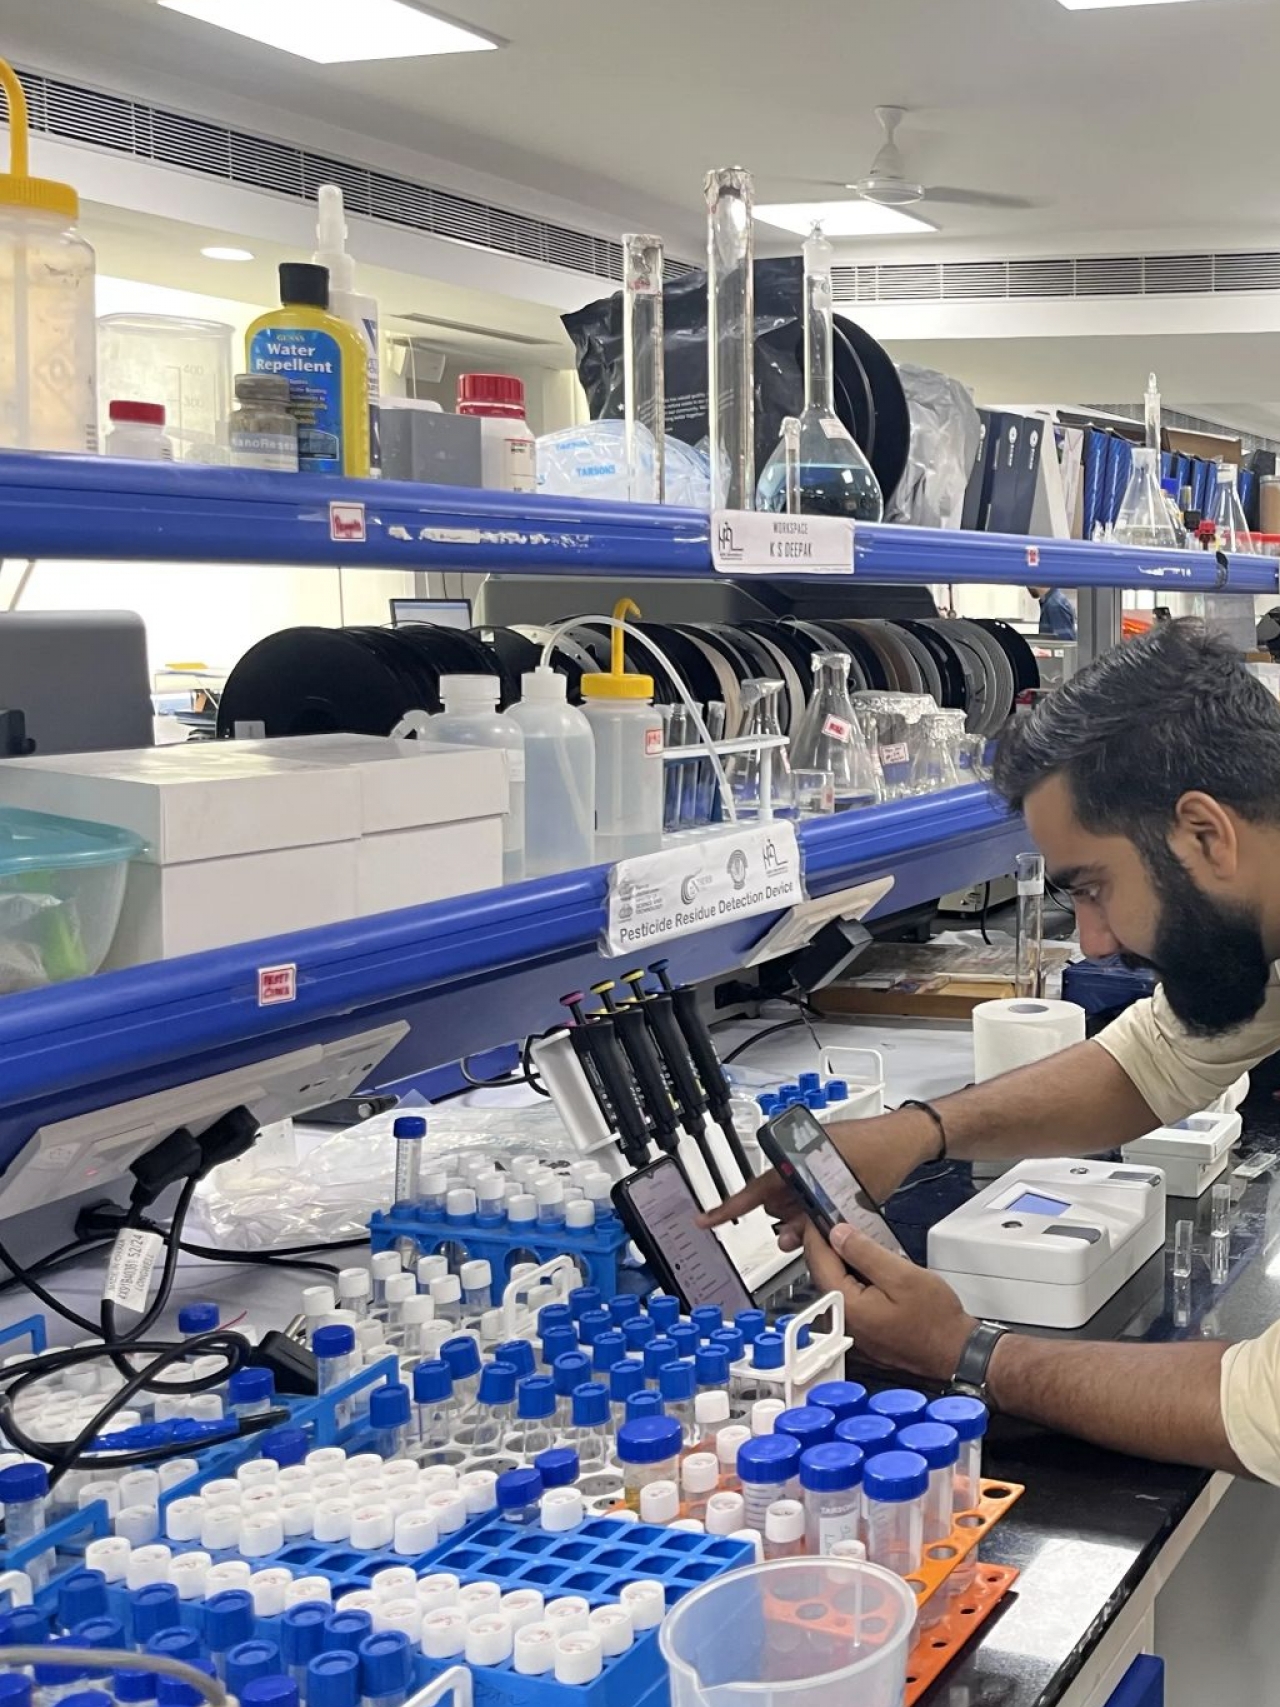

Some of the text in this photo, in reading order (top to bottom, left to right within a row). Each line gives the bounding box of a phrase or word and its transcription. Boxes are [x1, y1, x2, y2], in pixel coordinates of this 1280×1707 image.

[267, 343, 316, 357] Water
[255, 358, 334, 374] Repellent
[576, 464, 616, 478] TARSONS
[773, 521, 808, 534] WORKSPACE
[770, 542, 813, 558] K S DEEPAK
[619, 881, 794, 943] Pesticide Residue Detection Device
